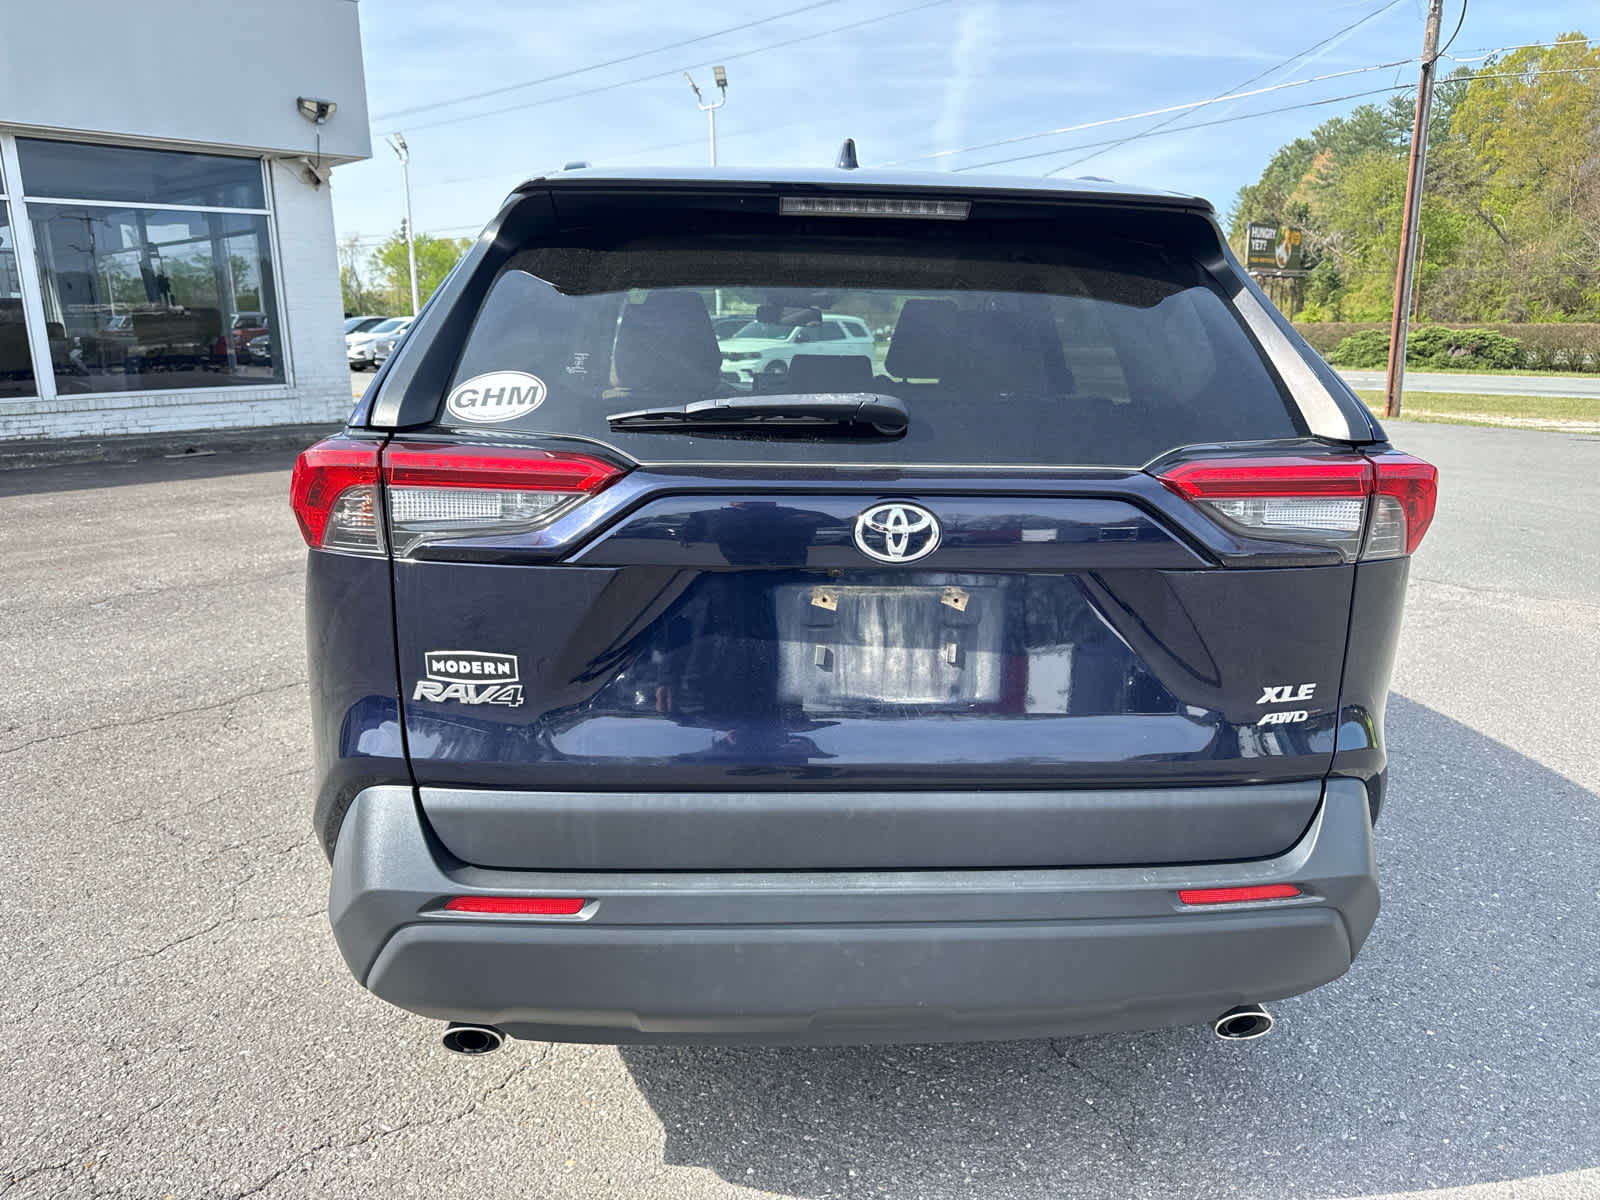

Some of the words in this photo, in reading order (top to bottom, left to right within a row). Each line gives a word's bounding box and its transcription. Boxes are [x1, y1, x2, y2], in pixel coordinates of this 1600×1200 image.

[454, 386, 539, 408] GHM
[431, 659, 510, 675] MODERN
[412, 680, 525, 707] RAV4
[1256, 683, 1317, 705] XLE
[1256, 710, 1309, 727] AWD
